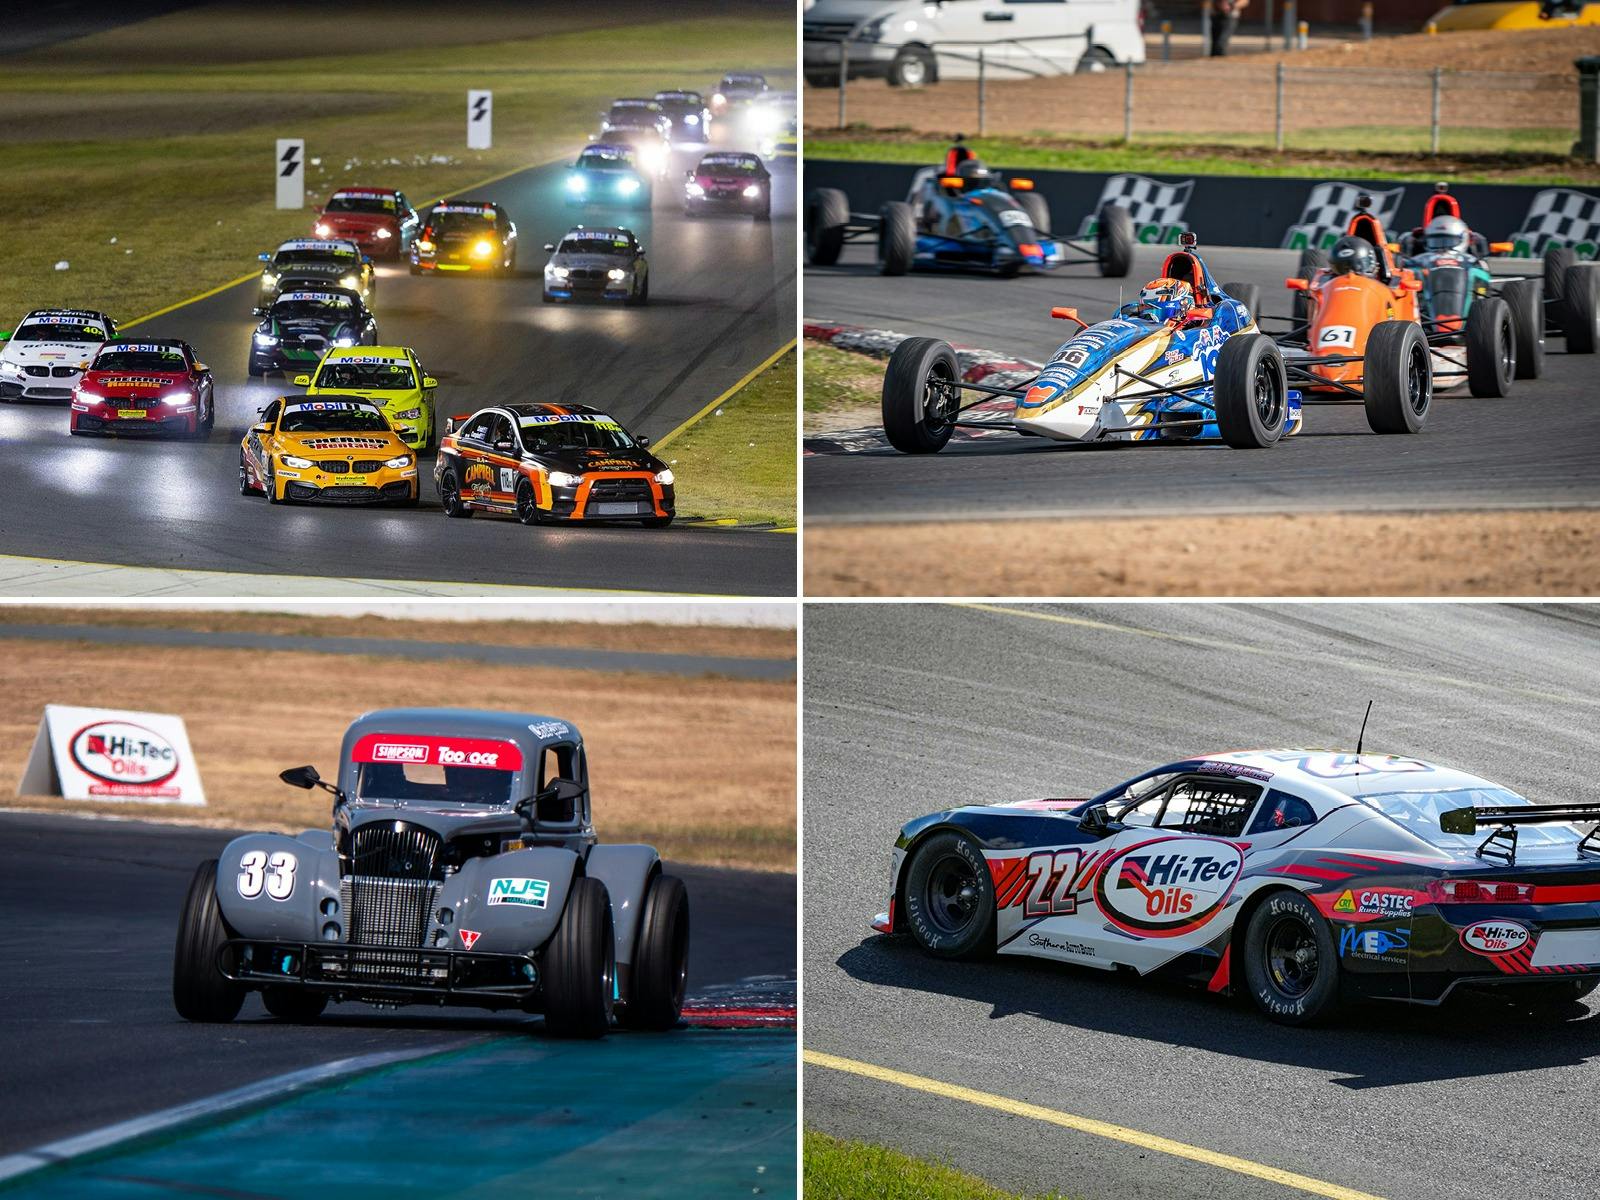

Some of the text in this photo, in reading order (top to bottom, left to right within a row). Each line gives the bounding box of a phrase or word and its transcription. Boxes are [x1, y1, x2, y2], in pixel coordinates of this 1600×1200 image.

[1320, 329, 1353, 343] 61
[117, 344, 154, 352] Mobil
[300, 403, 343, 411] Mobil
[534, 414, 579, 422] Mobil
[588, 459, 640, 468] CAMPBELL
[465, 464, 496, 486] CAMPBELL
[110, 736, 171, 760] Hi-Tec
[378, 745, 424, 759] SIMPSON
[112, 759, 147, 775] Oils
[955, 839, 985, 892] Hoosier
[1146, 854, 1238, 887] Hi-Tec
[237, 850, 299, 902] 33
[1023, 848, 1082, 919] 22
[492, 879, 548, 897] NJS
[1146, 887, 1193, 916] Oils
[1339, 898, 1352, 908] CRT
[1360, 892, 1414, 910] CASTEC
[1270, 898, 1315, 926] Hoosier
[1359, 906, 1411, 917] Rural Supplies
[1486, 927, 1526, 939] Hi-Tec
[1028, 933, 1066, 950] Southern
[1484, 938, 1508, 949] Oils
[1351, 951, 1407, 965] electrical services
[1259, 989, 1305, 1016] Hoosier
